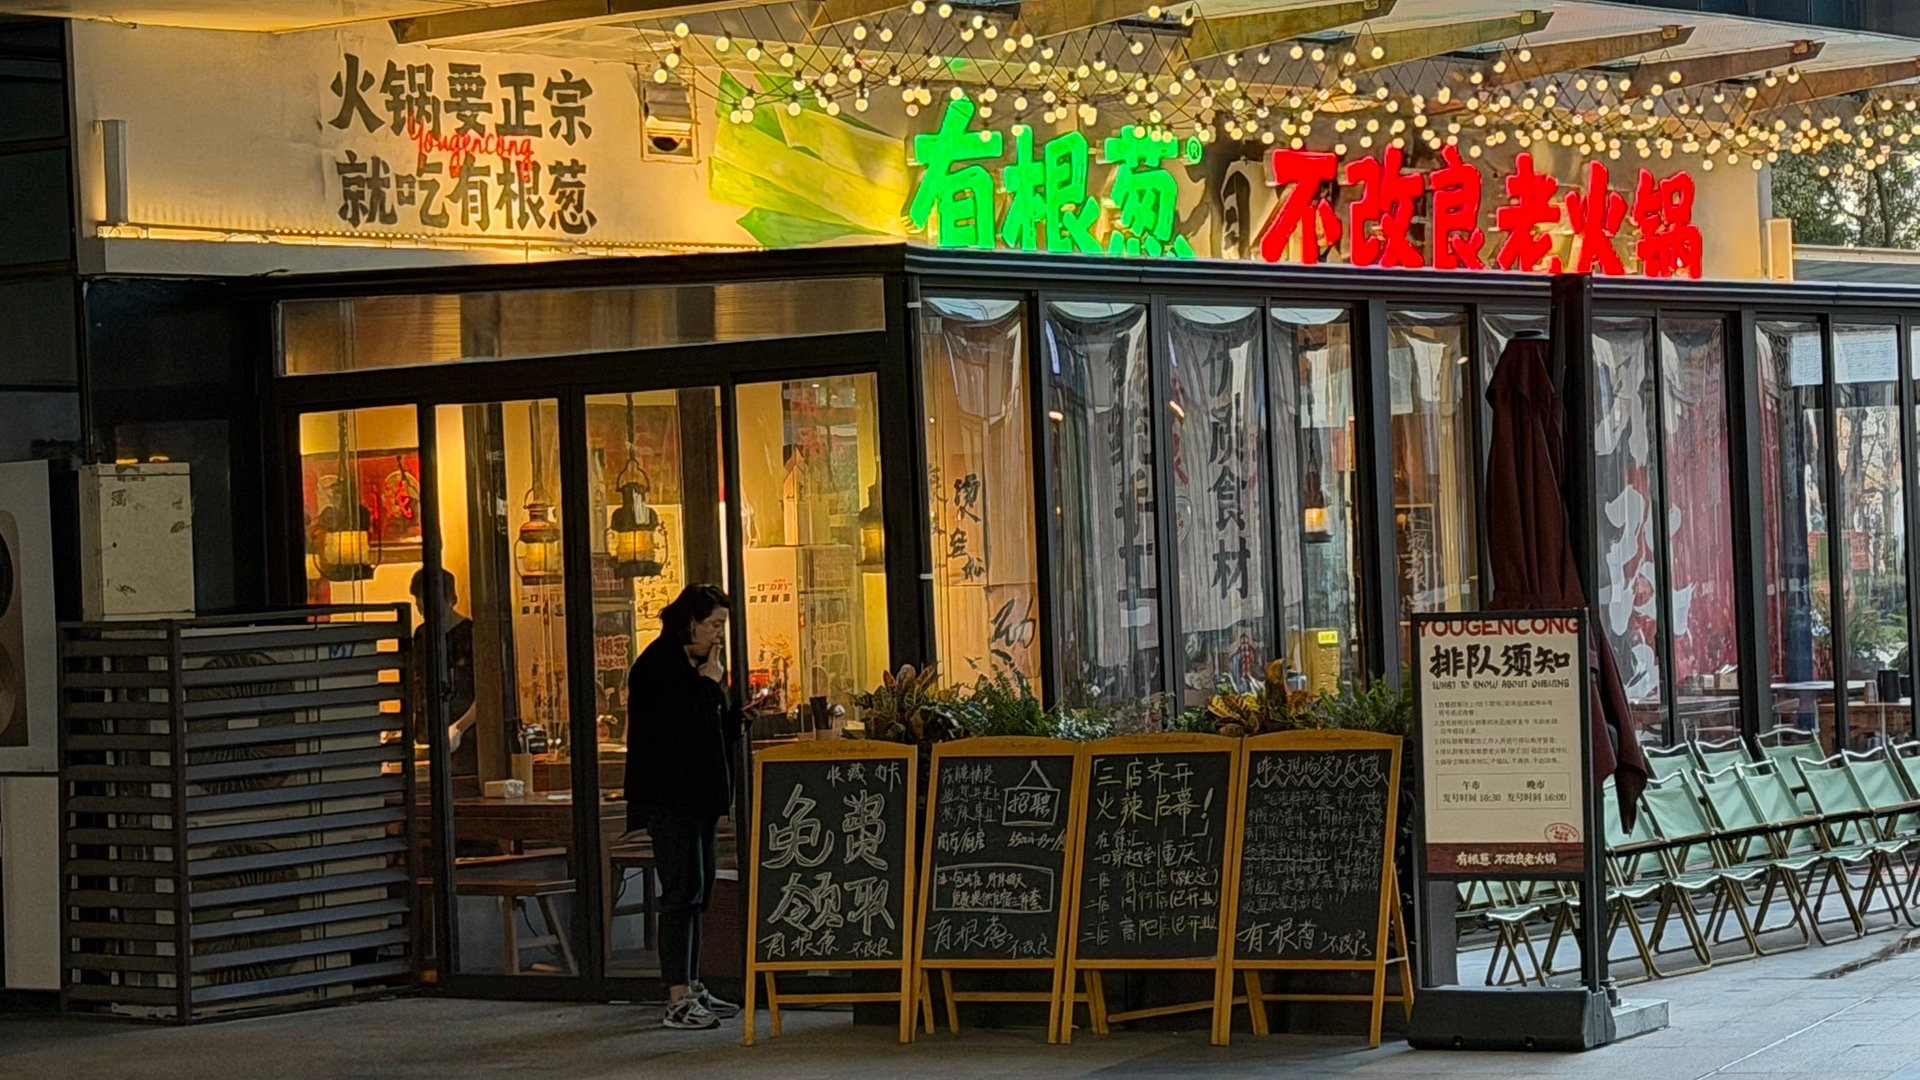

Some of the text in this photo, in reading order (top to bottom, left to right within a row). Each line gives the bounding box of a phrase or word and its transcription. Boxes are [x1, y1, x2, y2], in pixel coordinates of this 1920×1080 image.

[329, 53, 593, 145] 火锅要正宗
[337, 150, 597, 234] 就吃有根葱
[1260, 144, 1702, 279] 不改良老火锅
[1419, 618, 1578, 637] YOUGENCONG
[1429, 642, 1571, 678] 排队须知
[1432, 680, 1456, 690] WHAT
[1461, 680, 1469, 690] TO
[1472, 680, 1498, 690] KNOW
[1501, 679, 1528, 689] ABOUT
[1007, 794, 1051, 818] 招聘
[1544, 792, 1567, 801] 16:00
[761, 783, 889, 871] 免费
[1494, 852, 1557, 867] 不改良老火锅
[767, 872, 895, 935] 领取
